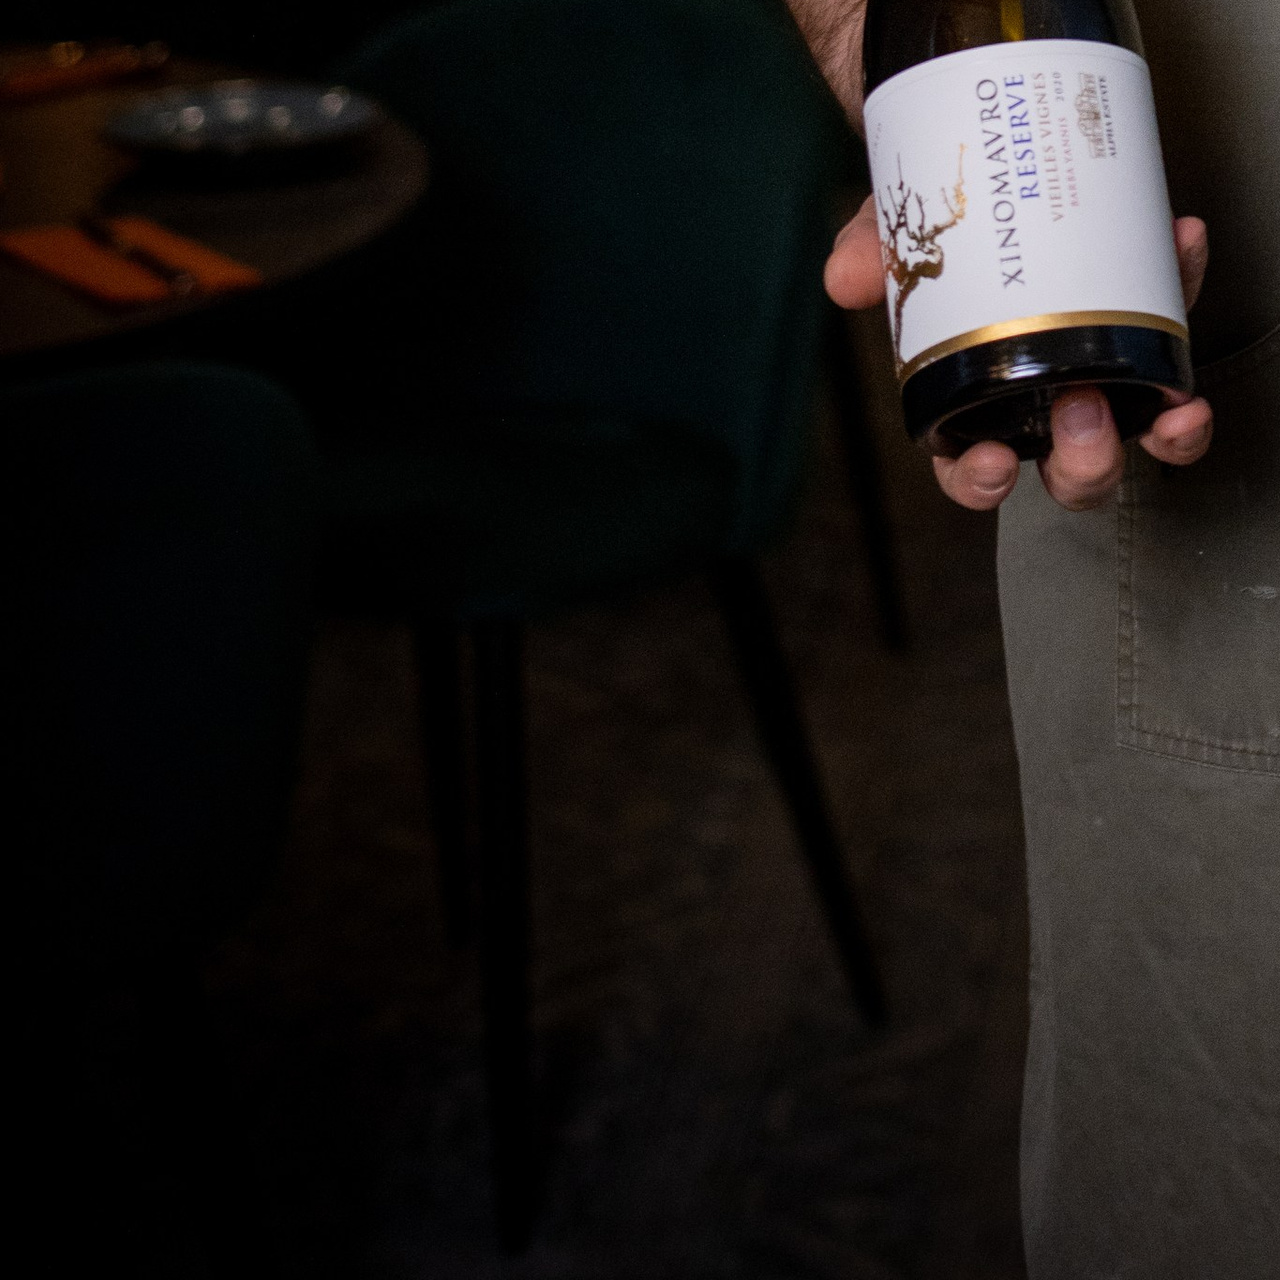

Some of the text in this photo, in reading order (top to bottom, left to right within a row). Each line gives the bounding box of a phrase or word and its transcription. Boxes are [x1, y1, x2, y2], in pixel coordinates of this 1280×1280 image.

[1004, 74, 1040, 199] RESERVE
[1034, 72, 1064, 222] VIEILLES VIGNES
[1058, 117, 1073, 163] YANNIS
[1099, 76, 1117, 158] ALPHA ESTATE
[976, 79, 1025, 288] XINOMAVRO
[1067, 168, 1079, 207] BARBA
